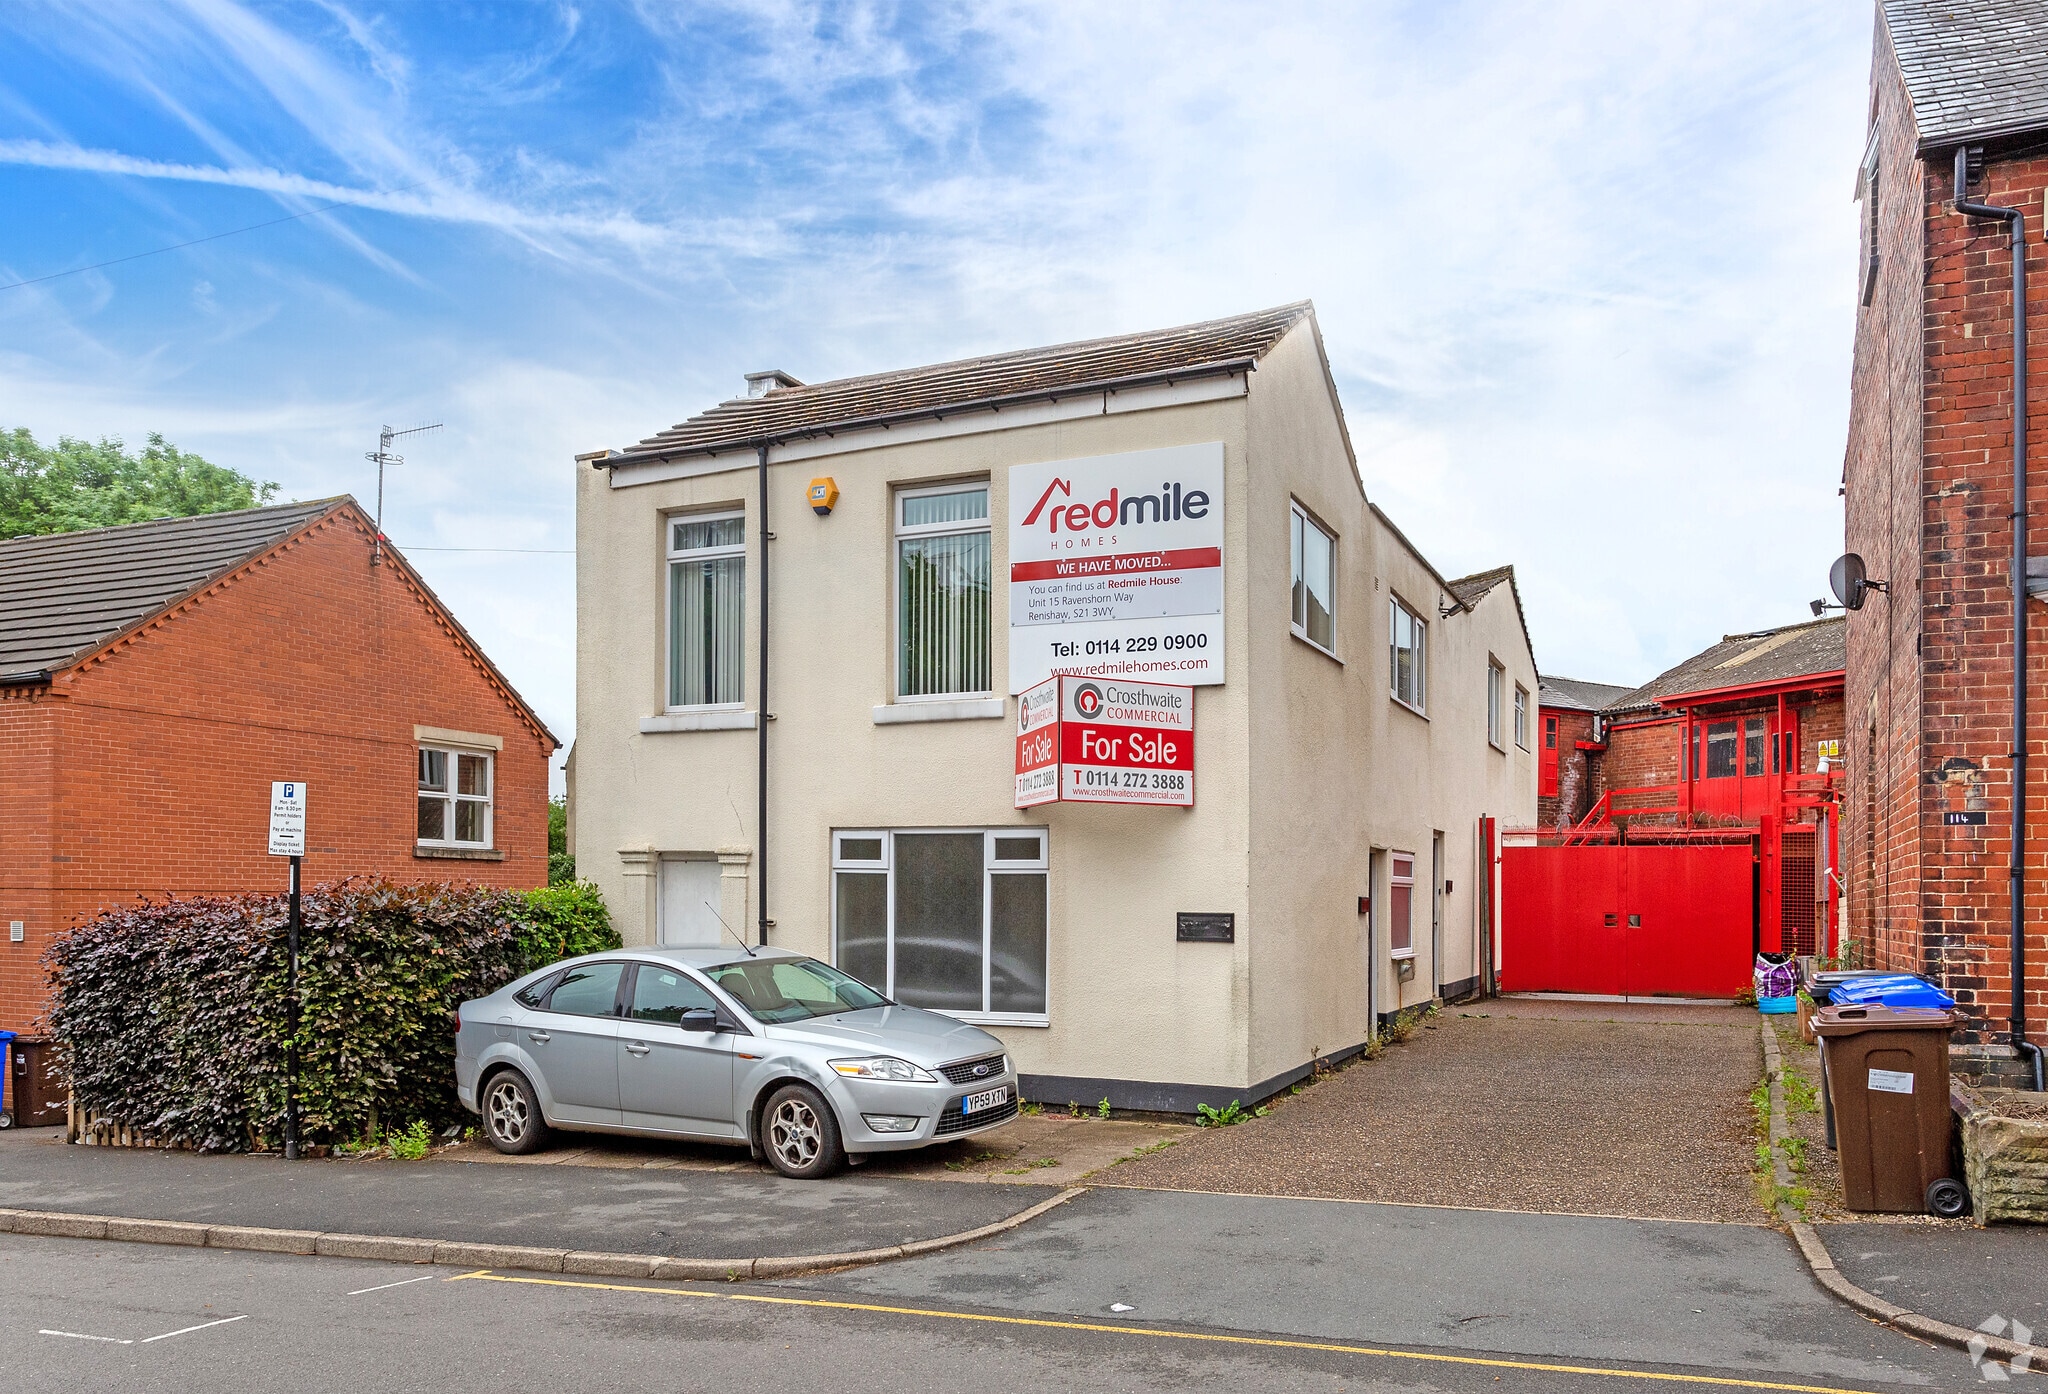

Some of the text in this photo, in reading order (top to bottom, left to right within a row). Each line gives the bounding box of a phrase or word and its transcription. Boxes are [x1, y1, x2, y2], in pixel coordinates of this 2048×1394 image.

[1050, 482, 1210, 534] redmile
[1051, 536, 1118, 550] HOMES
[1056, 556, 1171, 575] WE HAVE MOVED...
[1029, 585, 1046, 595] You
[1048, 585, 1063, 594] can
[1065, 582, 1082, 592] find
[1084, 583, 1097, 591] us
[1097, 581, 1106, 590] at
[1108, 577, 1147, 589] Redmile
[1028, 592, 1134, 608] Unit 15 Ravenshorn Way
[1028, 606, 1114, 621] Renishaw, S21 3WY
[1051, 633, 1208, 657] Tel: 0114 229 0900
[1051, 658, 1209, 677] www.redmilehomes.com
[1107, 687, 1182, 709] Crosthwaite
[1107, 707, 1182, 724] COMMERCIAL
[1022, 731, 1052, 767] For Sale
[1082, 729, 1177, 765] For Sale
[1019, 770, 1054, 792] T 0114 272 3888
[1073, 770, 1185, 791] T 0114 272 3888
[286, 785, 293, 797] P
[1072, 787, 1185, 801] www.crosthwaitecommercial.com
[1949, 814, 1969, 824] 114
[969, 1088, 1006, 1110] YP59 XTN
